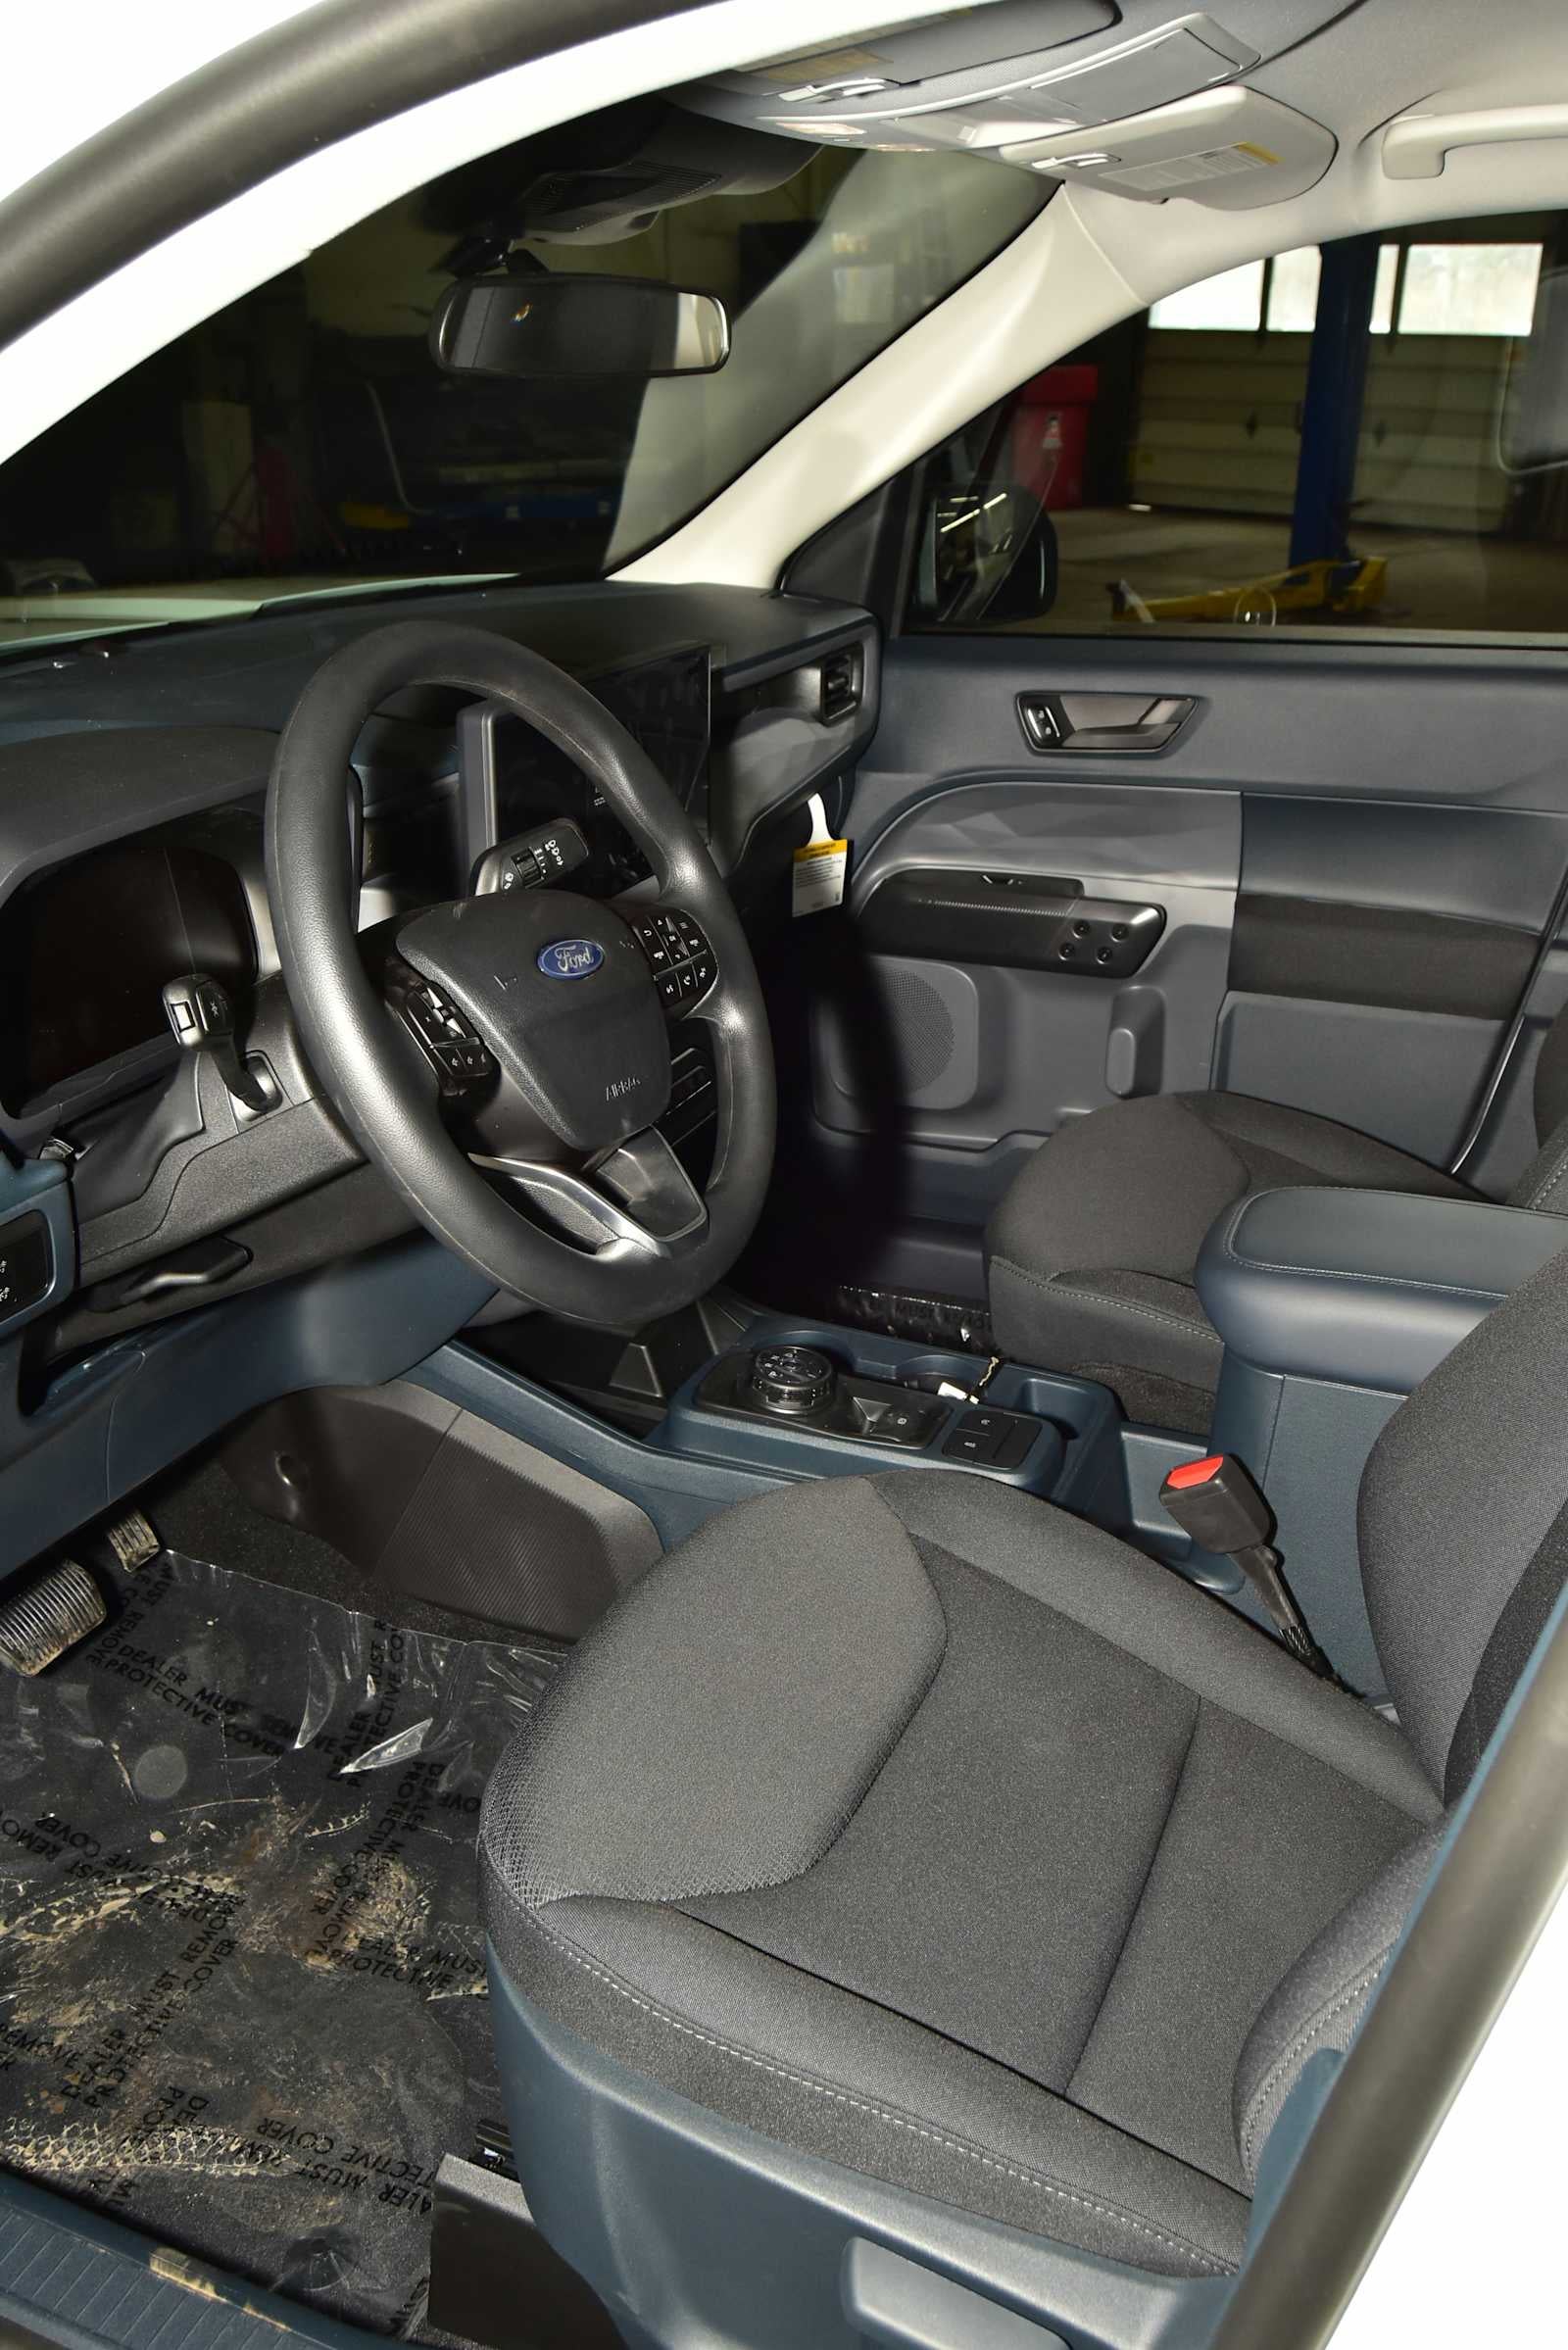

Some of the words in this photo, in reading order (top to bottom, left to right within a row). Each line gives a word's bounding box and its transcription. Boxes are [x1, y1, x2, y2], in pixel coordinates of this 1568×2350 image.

[554, 945, 595, 972] Ford
[86, 1610, 144, 1667] REMOVE
[105, 1658, 218, 1727] PROTECTIVE
[118, 1644, 188, 1687] DEALER
[194, 1687, 253, 1717] MUST
[33, 1815, 101, 1858] COVER
[183, 1937, 238, 1993] COVER
[256, 2117, 334, 2155] COVER
[340, 2145, 437, 2189] TECTIVE
[378, 2182, 433, 2216] ALER
